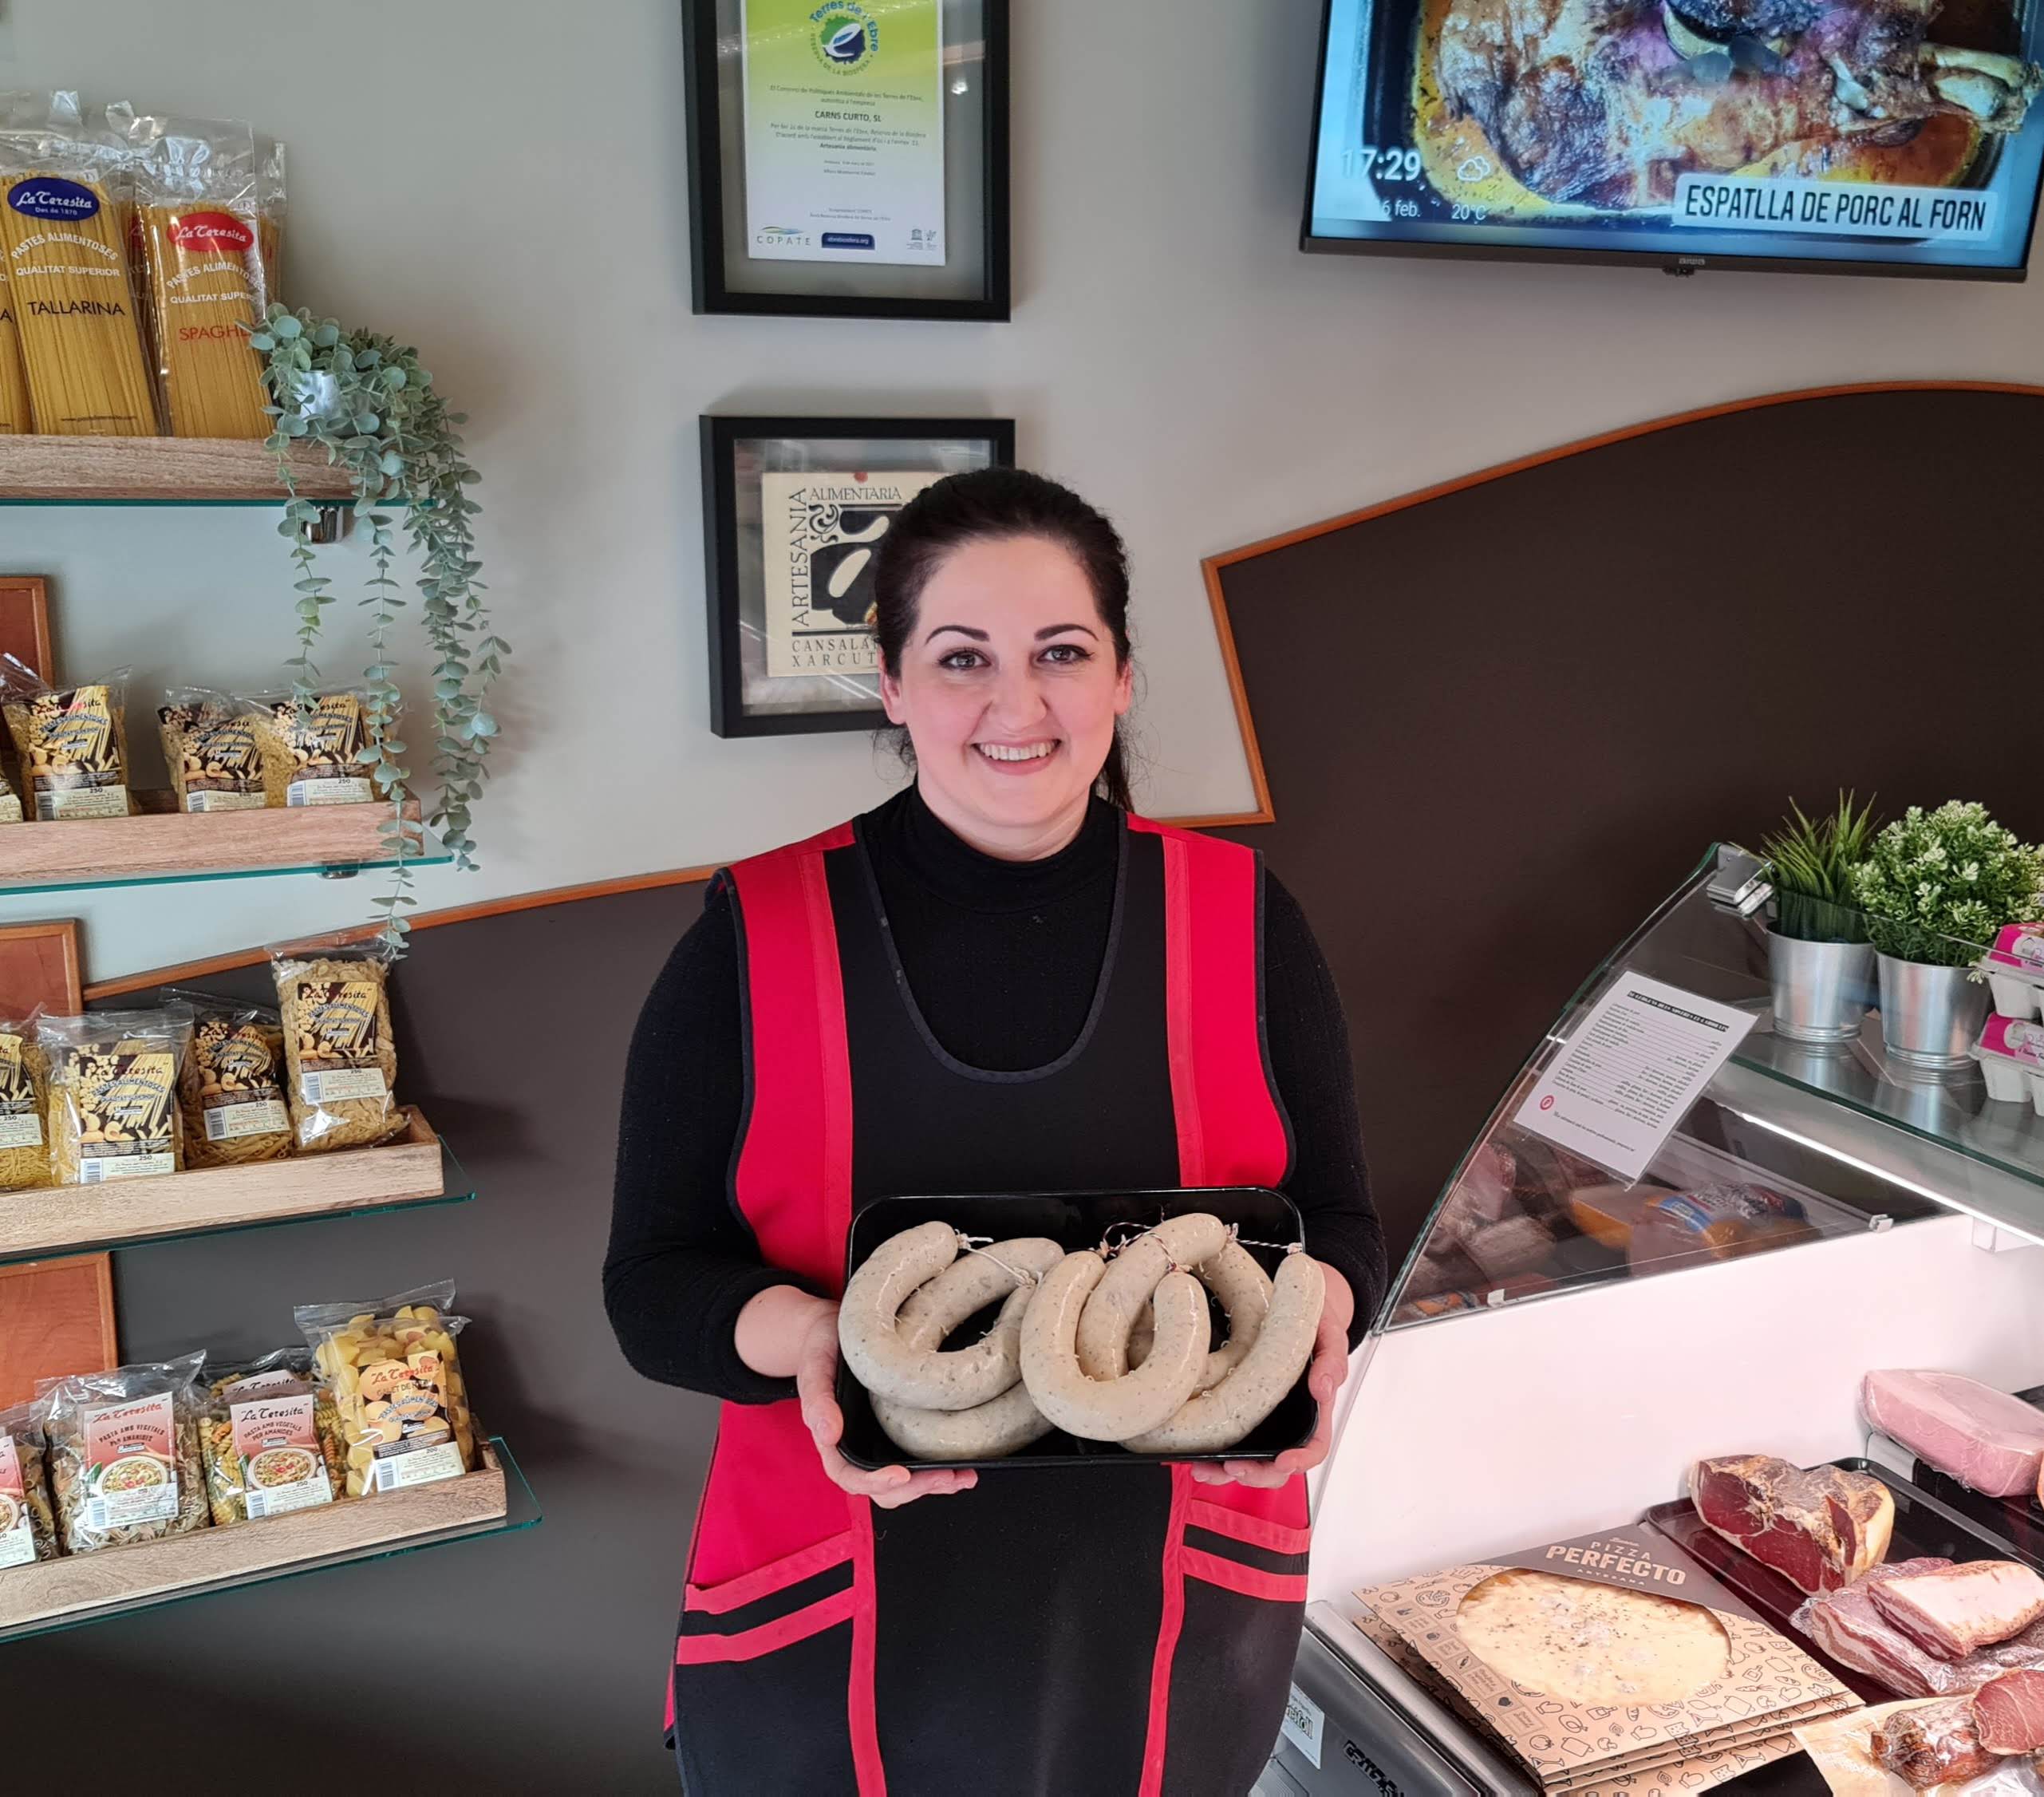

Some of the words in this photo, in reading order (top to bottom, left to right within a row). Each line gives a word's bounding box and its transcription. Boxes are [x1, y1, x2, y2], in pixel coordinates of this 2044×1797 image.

[809, 1, 843, 22] Terres
[847, 2, 862, 14] de
[815, 110, 842, 120] CARNS
[842, 113, 871, 123] CURTO,
[1342, 148, 1421, 181] 17:29
[16, 192, 36, 207] La
[36, 191, 93, 209] Teresita
[1685, 184, 1794, 222] ESPATLLA
[1800, 192, 1828, 223] DE
[1835, 195, 1894, 227] PORC
[1897, 198, 1923, 228] AL
[1928, 199, 1987, 231] FORN
[1395, 201, 1421, 217] feb.
[1451, 204, 1487, 220] 20°C
[176, 226, 193, 239] La
[194, 225, 247, 242] Teresita
[756, 235, 811, 246] COPATE
[11, 234, 45, 259] PASTES
[48, 232, 118, 260] ALIMENTOSES
[16, 265, 65, 276] QUALITAT
[68, 265, 120, 276] SUPERIOR
[166, 266, 200, 289] PASTES
[170, 294, 218, 304] QUALITAT
[27, 300, 125, 316] TALLARINA
[810, 487, 902, 501] ALIMENTARIA
[788, 488, 809, 626] ARTESANIA
[241, 1409, 257, 1422] La
[258, 1407, 304, 1420] Teresita
[1591, 1541, 1651, 1561] PIZZA
[1545, 1545, 1687, 1586] PERFECTO
